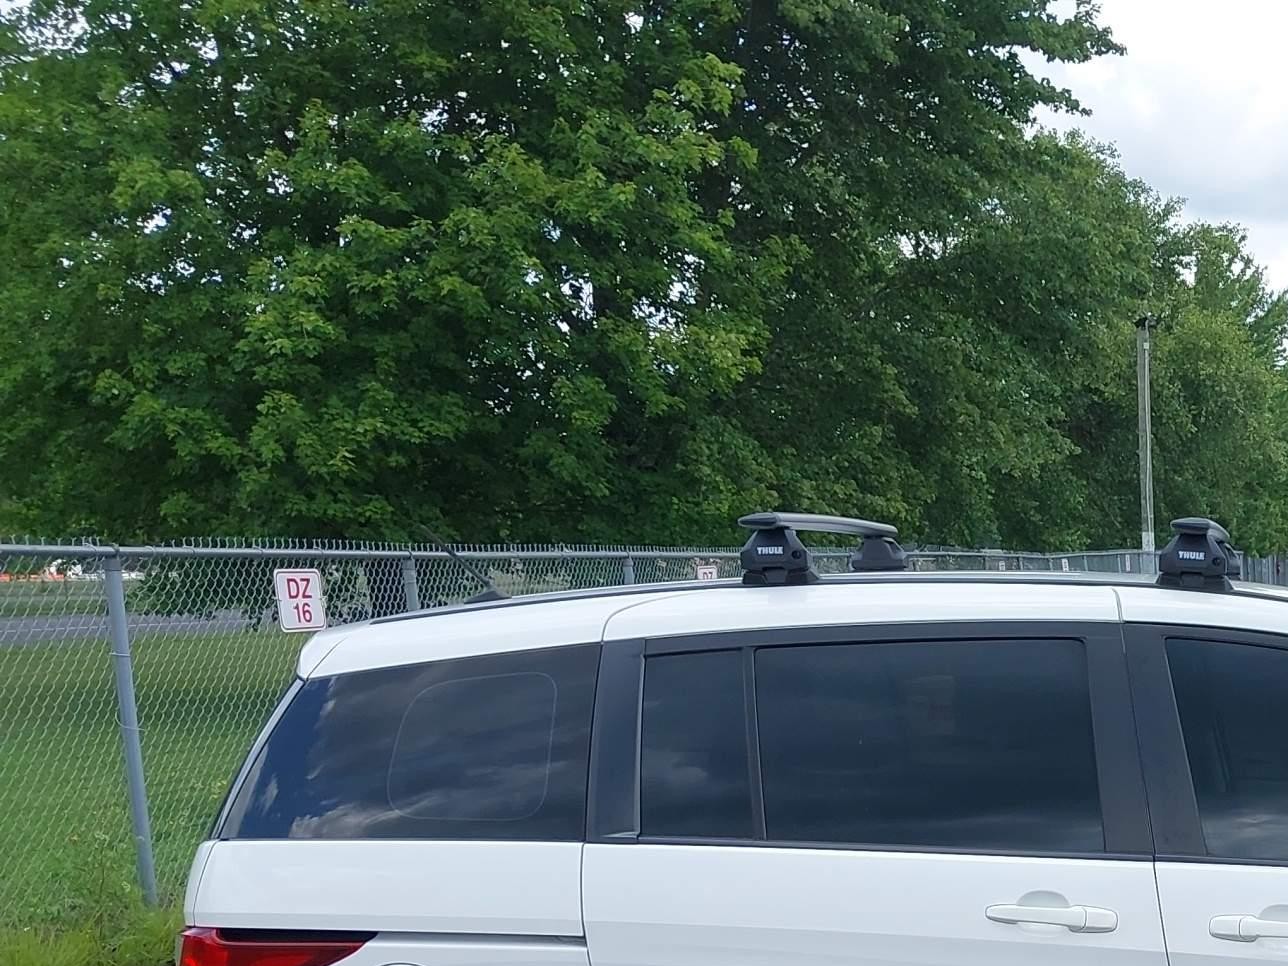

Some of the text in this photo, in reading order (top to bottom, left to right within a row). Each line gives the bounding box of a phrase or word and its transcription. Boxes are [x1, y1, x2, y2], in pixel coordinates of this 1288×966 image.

[757, 546, 784, 555] THULE
[1178, 550, 1206, 560] THULE
[286, 577, 313, 599] DZ
[293, 602, 313, 623] 16
